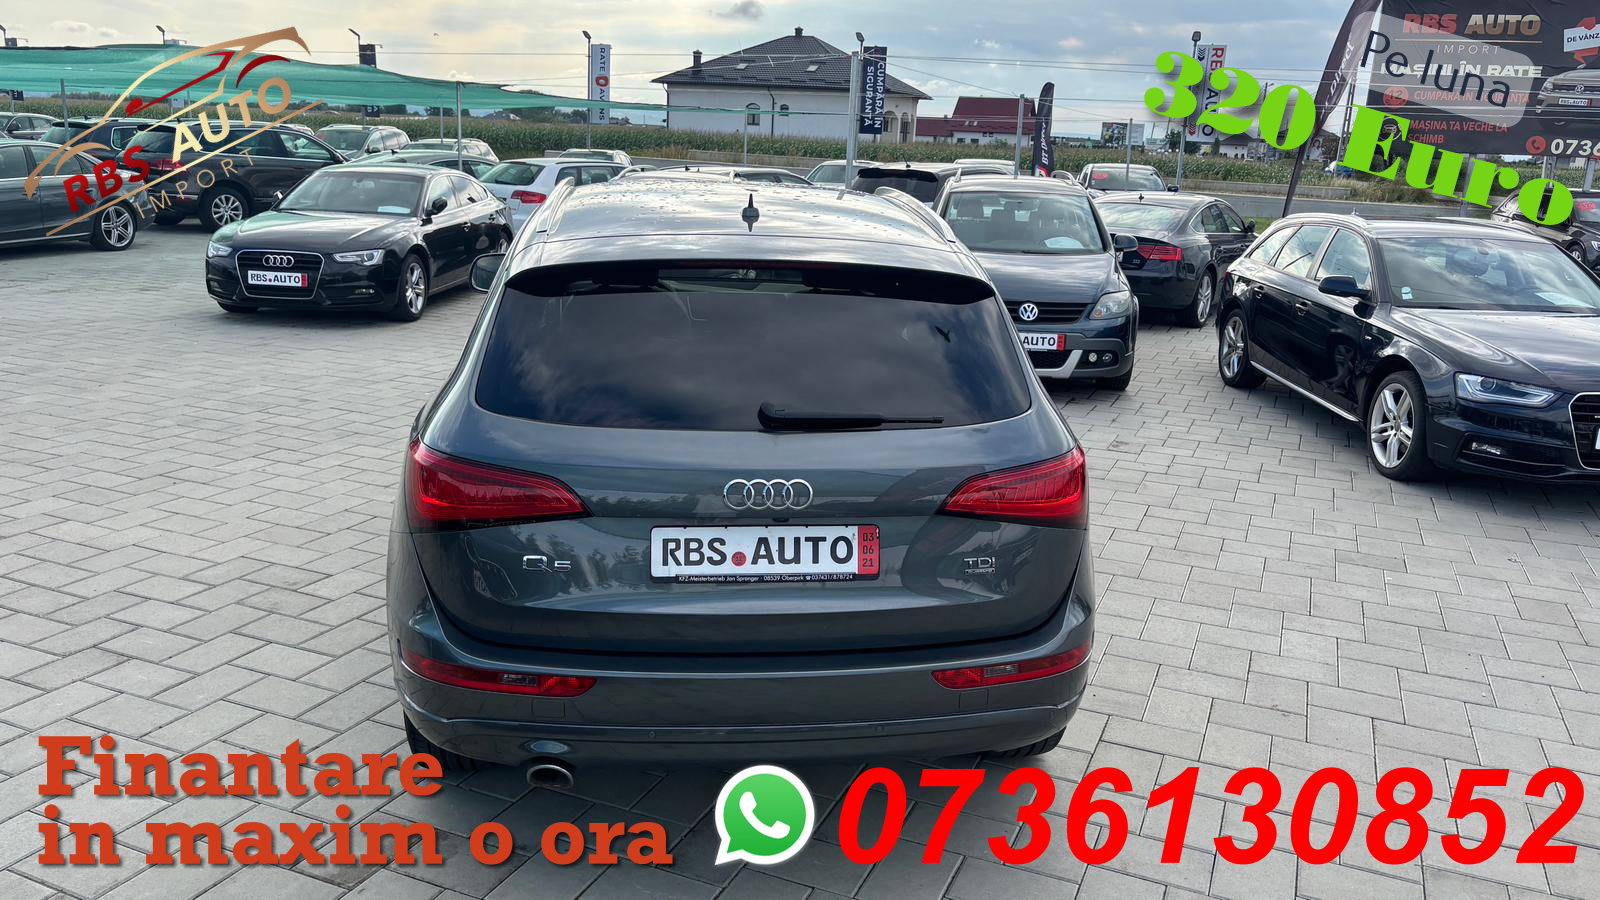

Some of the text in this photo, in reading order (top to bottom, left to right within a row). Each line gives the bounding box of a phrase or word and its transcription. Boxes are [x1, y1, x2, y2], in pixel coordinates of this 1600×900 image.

[1402, 13, 1541, 36] RBS AUTO
[1567, 35, 1577, 43] DE
[1436, 44, 1499, 55] IMPORT
[1487, 65, 1542, 77] RATE
[1202, 88, 1219, 136] AUO
[1449, 121, 1460, 131] TA
[1496, 122, 1508, 132] LA
[1407, 133, 1445, 144] SCHIMB
[273, 274, 300, 284] AUTO
[1022, 336, 1056, 346] AUTO
[862, 532, 874, 542] 03
[661, 535, 853, 567] RBS AUTO
[862, 545, 874, 555] 06
[523, 555, 571, 573] Q5
[862, 558, 874, 568] 21
[964, 556, 996, 568] TDI
